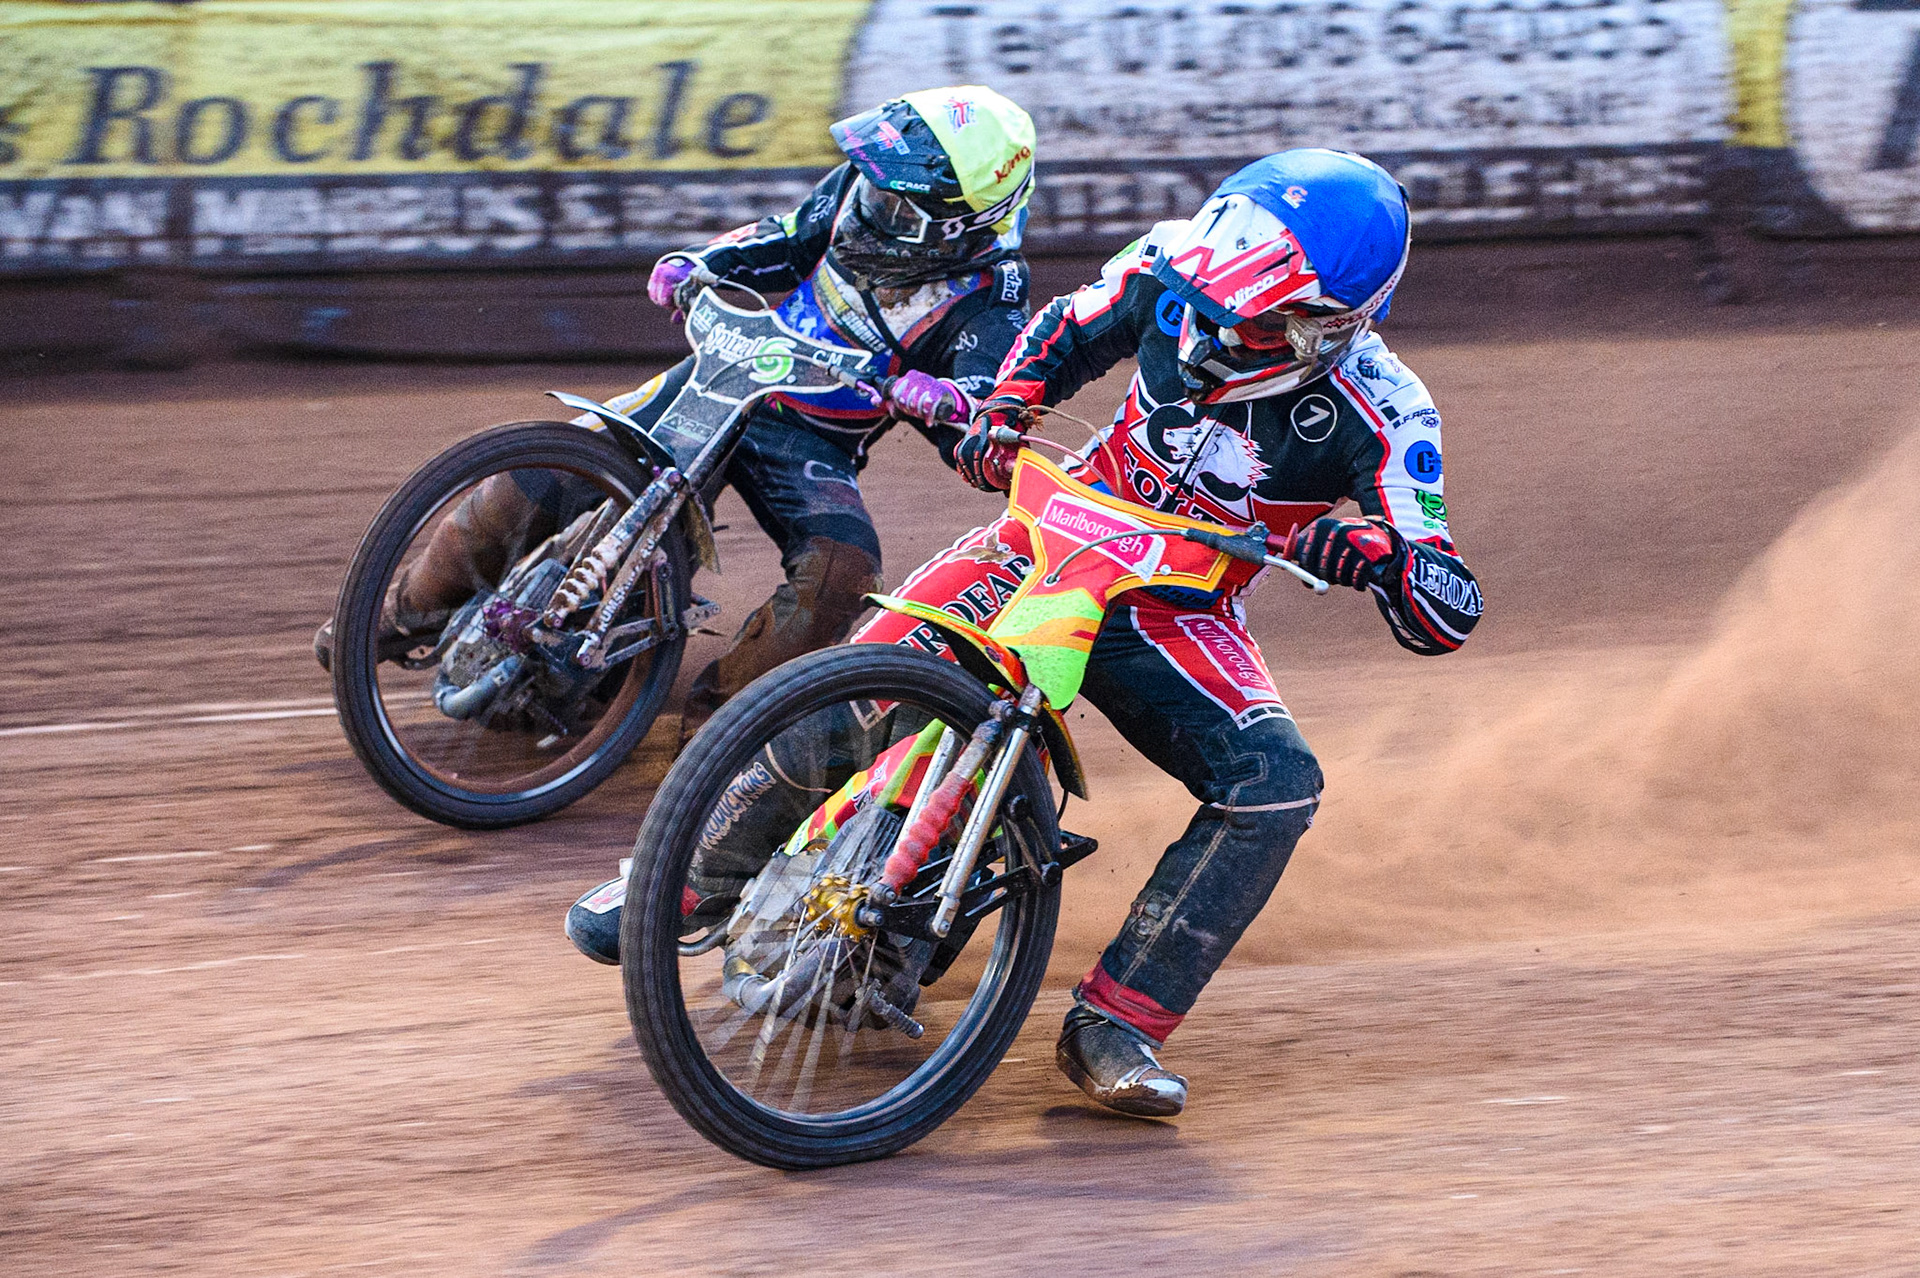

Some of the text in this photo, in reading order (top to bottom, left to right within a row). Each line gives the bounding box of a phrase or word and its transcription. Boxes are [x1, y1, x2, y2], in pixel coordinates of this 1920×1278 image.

[62, 60, 775, 166] Rochdale
[1224, 274, 1276, 311] Nitro
[705, 322, 767, 355] Spiral
[1195, 620, 1268, 689] rlborough
